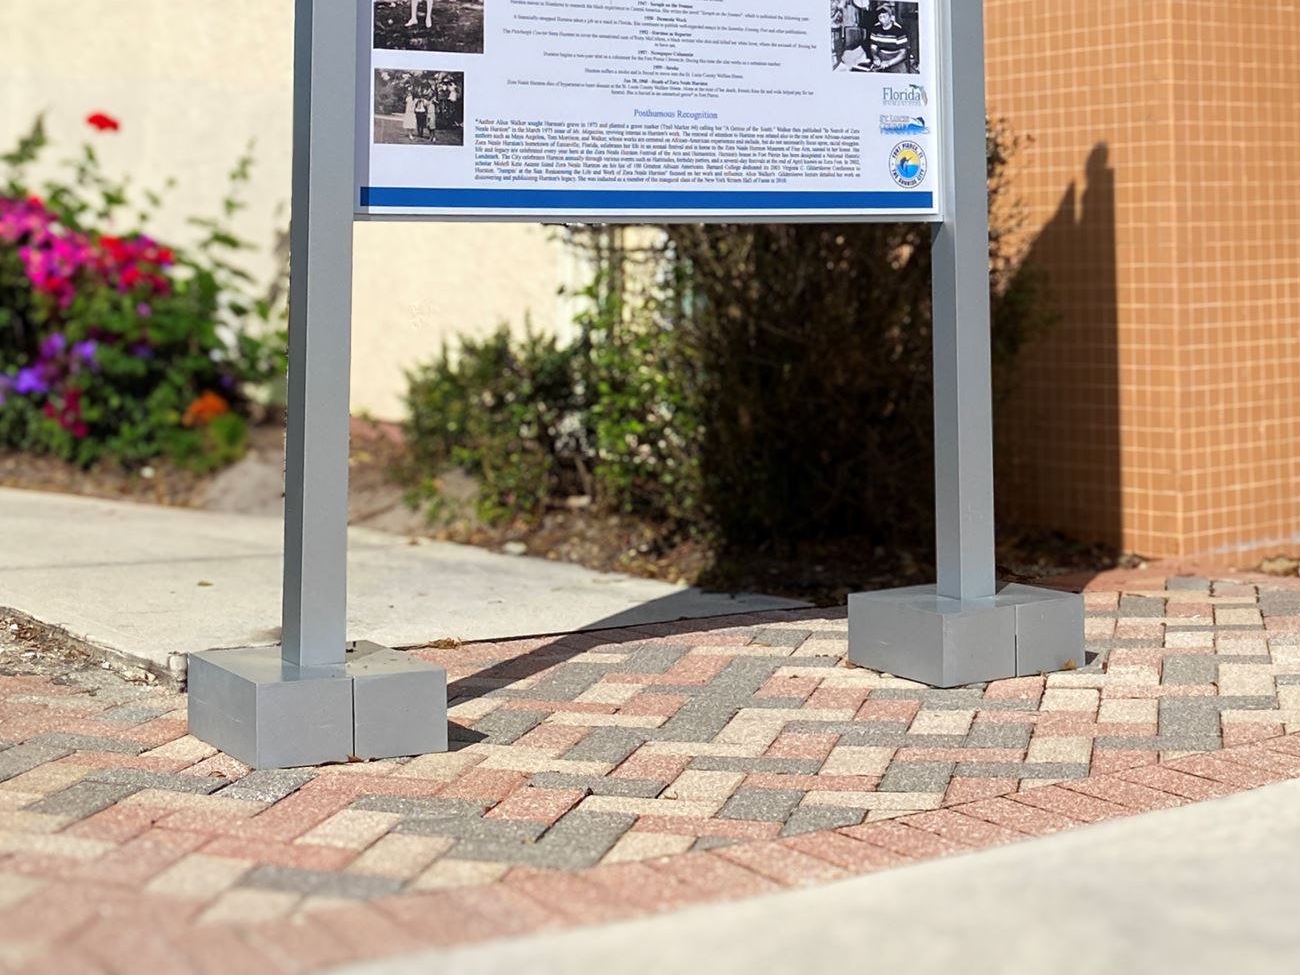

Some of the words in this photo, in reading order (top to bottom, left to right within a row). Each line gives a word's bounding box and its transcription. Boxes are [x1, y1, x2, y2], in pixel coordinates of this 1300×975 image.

[883, 86, 921, 101] Florida
[634, 109, 675, 118] Posthumous
[676, 110, 717, 120] Recognition
